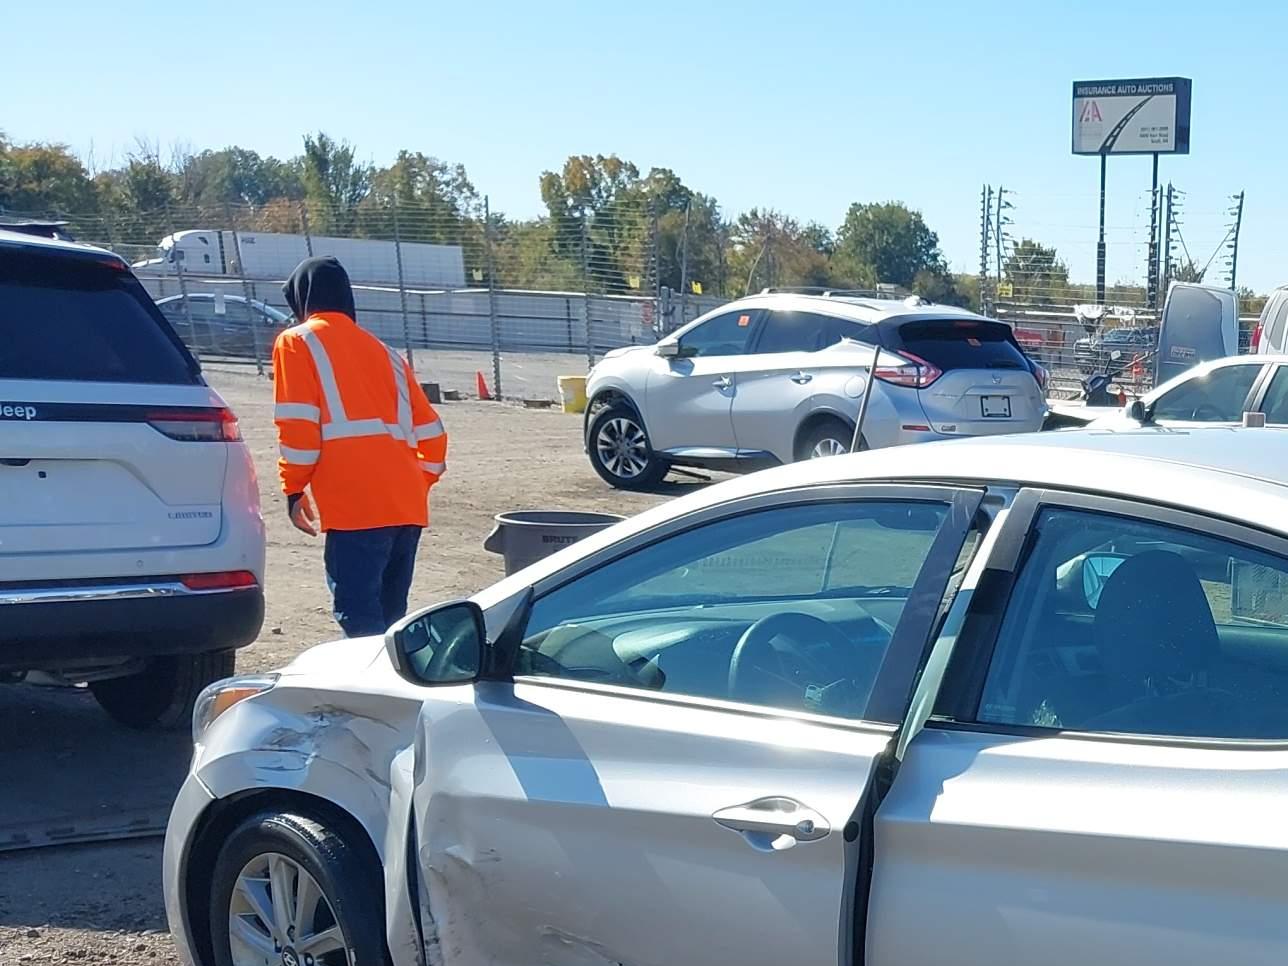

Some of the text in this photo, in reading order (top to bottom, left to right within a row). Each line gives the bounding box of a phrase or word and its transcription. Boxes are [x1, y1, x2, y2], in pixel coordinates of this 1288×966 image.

[1077, 83, 1174, 96] INSURANCE AUTO AUCTIONS
